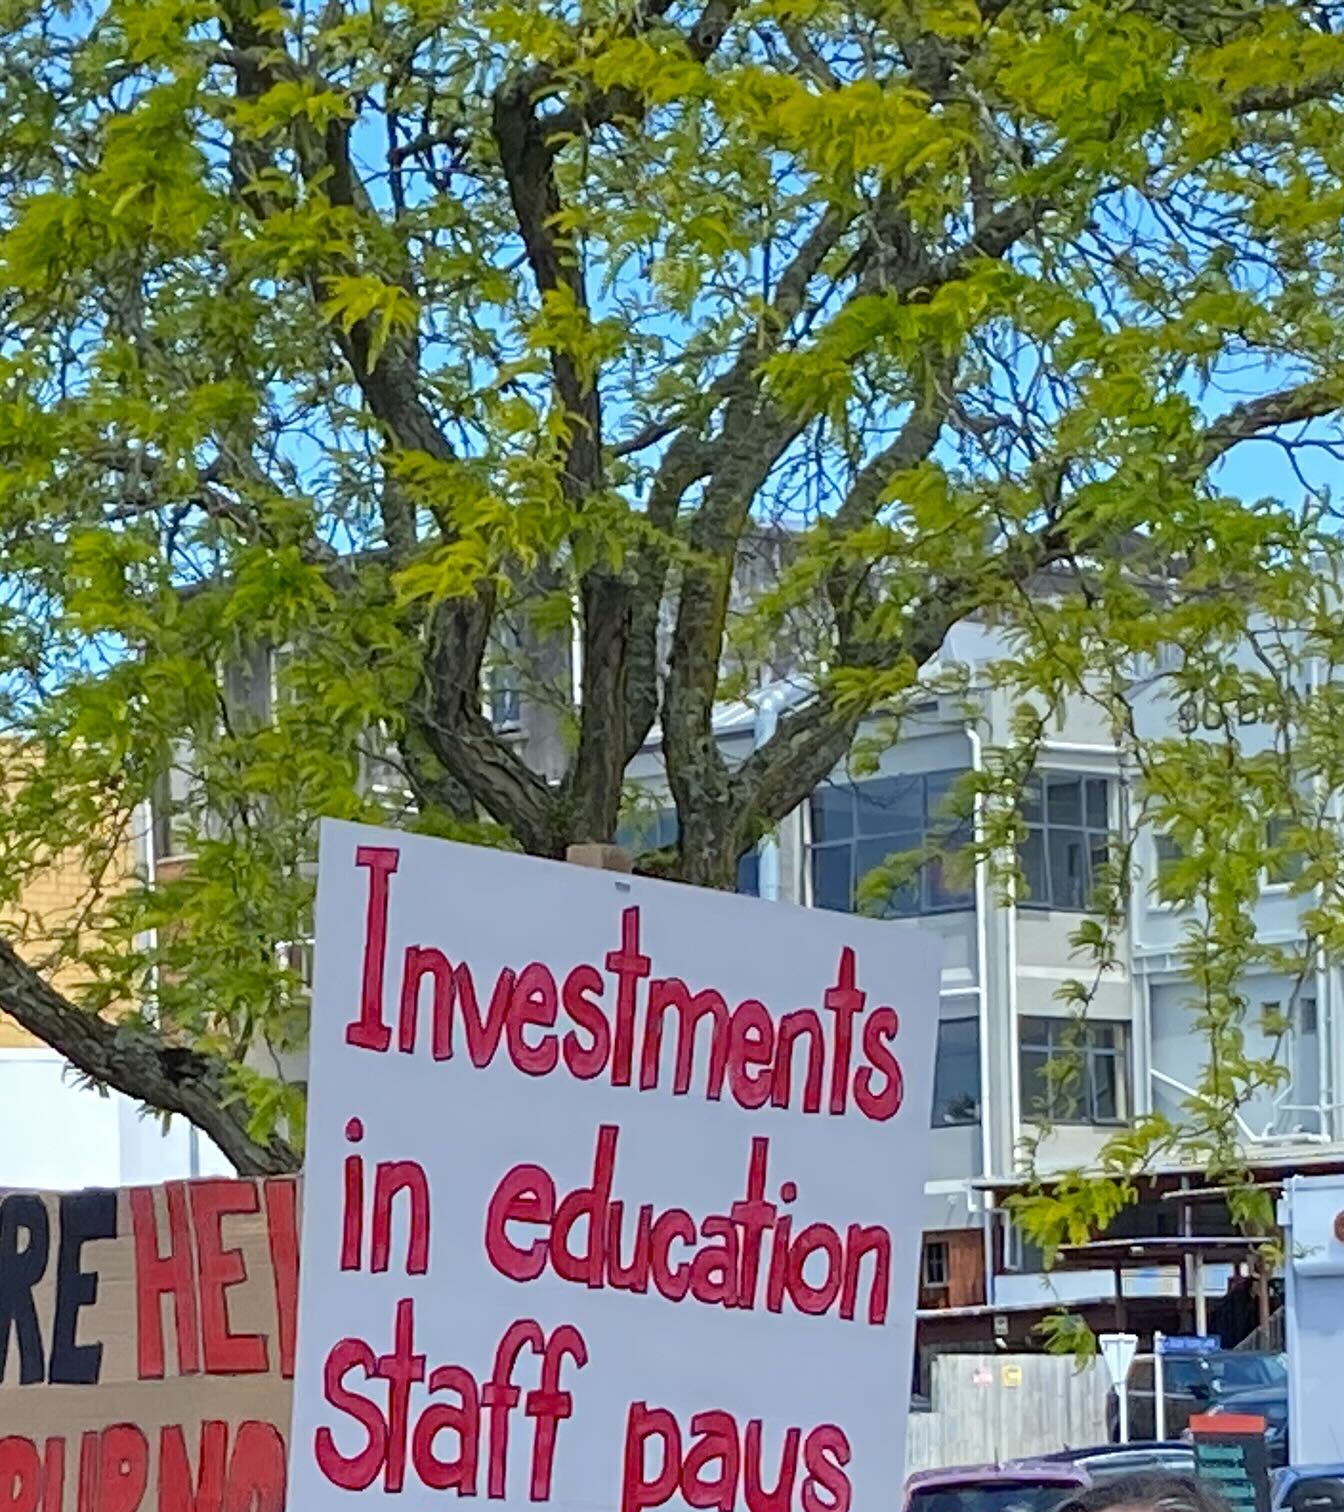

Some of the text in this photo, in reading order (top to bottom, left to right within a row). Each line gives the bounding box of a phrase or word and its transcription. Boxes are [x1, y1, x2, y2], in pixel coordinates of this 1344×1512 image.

[346, 846, 904, 1121] Investments
[340, 1116, 891, 1325] in education
